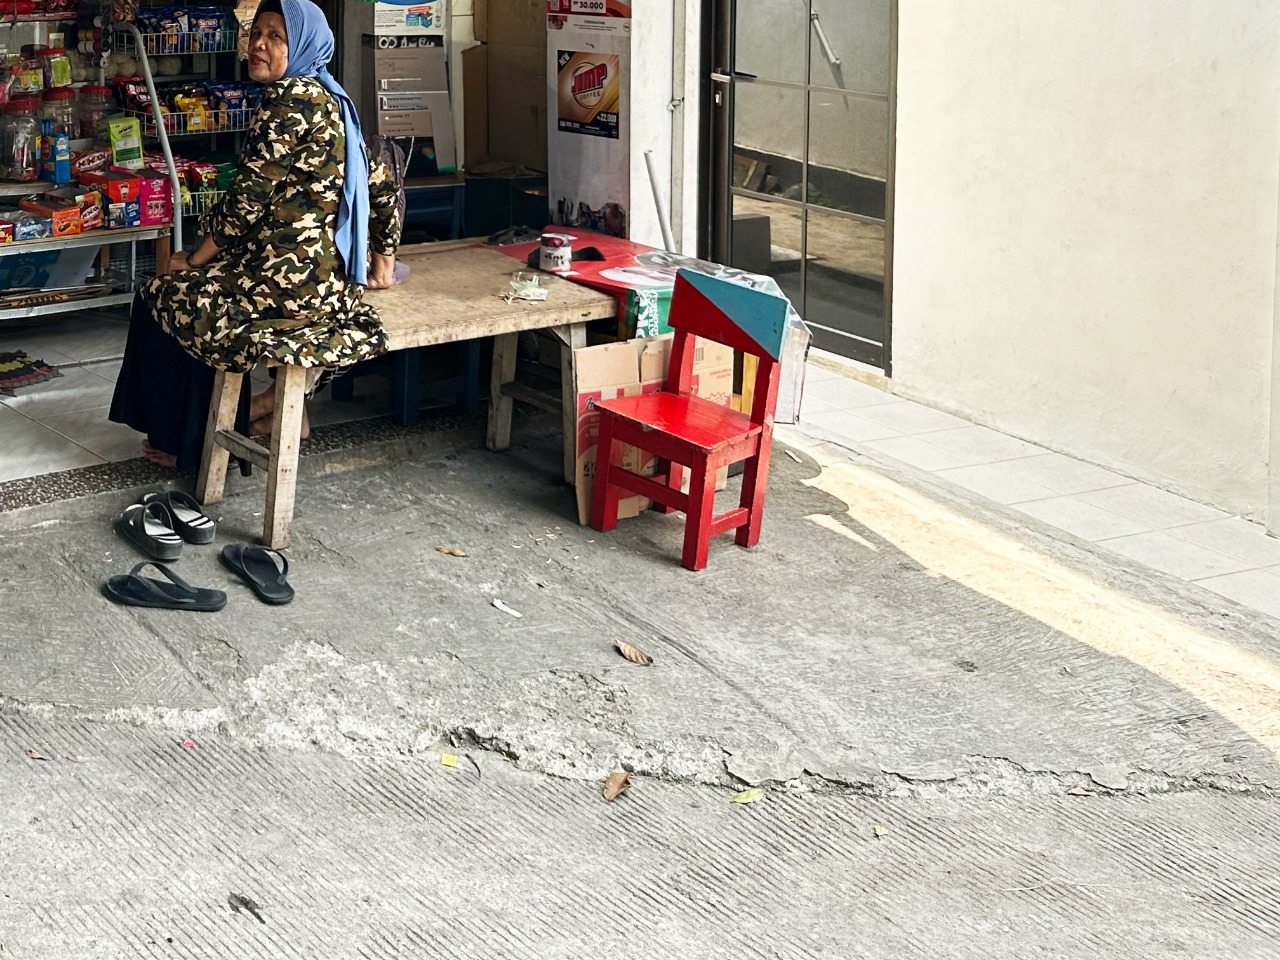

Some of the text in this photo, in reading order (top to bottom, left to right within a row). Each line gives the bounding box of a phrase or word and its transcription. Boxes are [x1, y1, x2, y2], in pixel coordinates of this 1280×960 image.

[580, 1, 604, 10] 30.000
[558, 51, 570, 67] NEW
[579, 90, 601, 100] COFFEE
